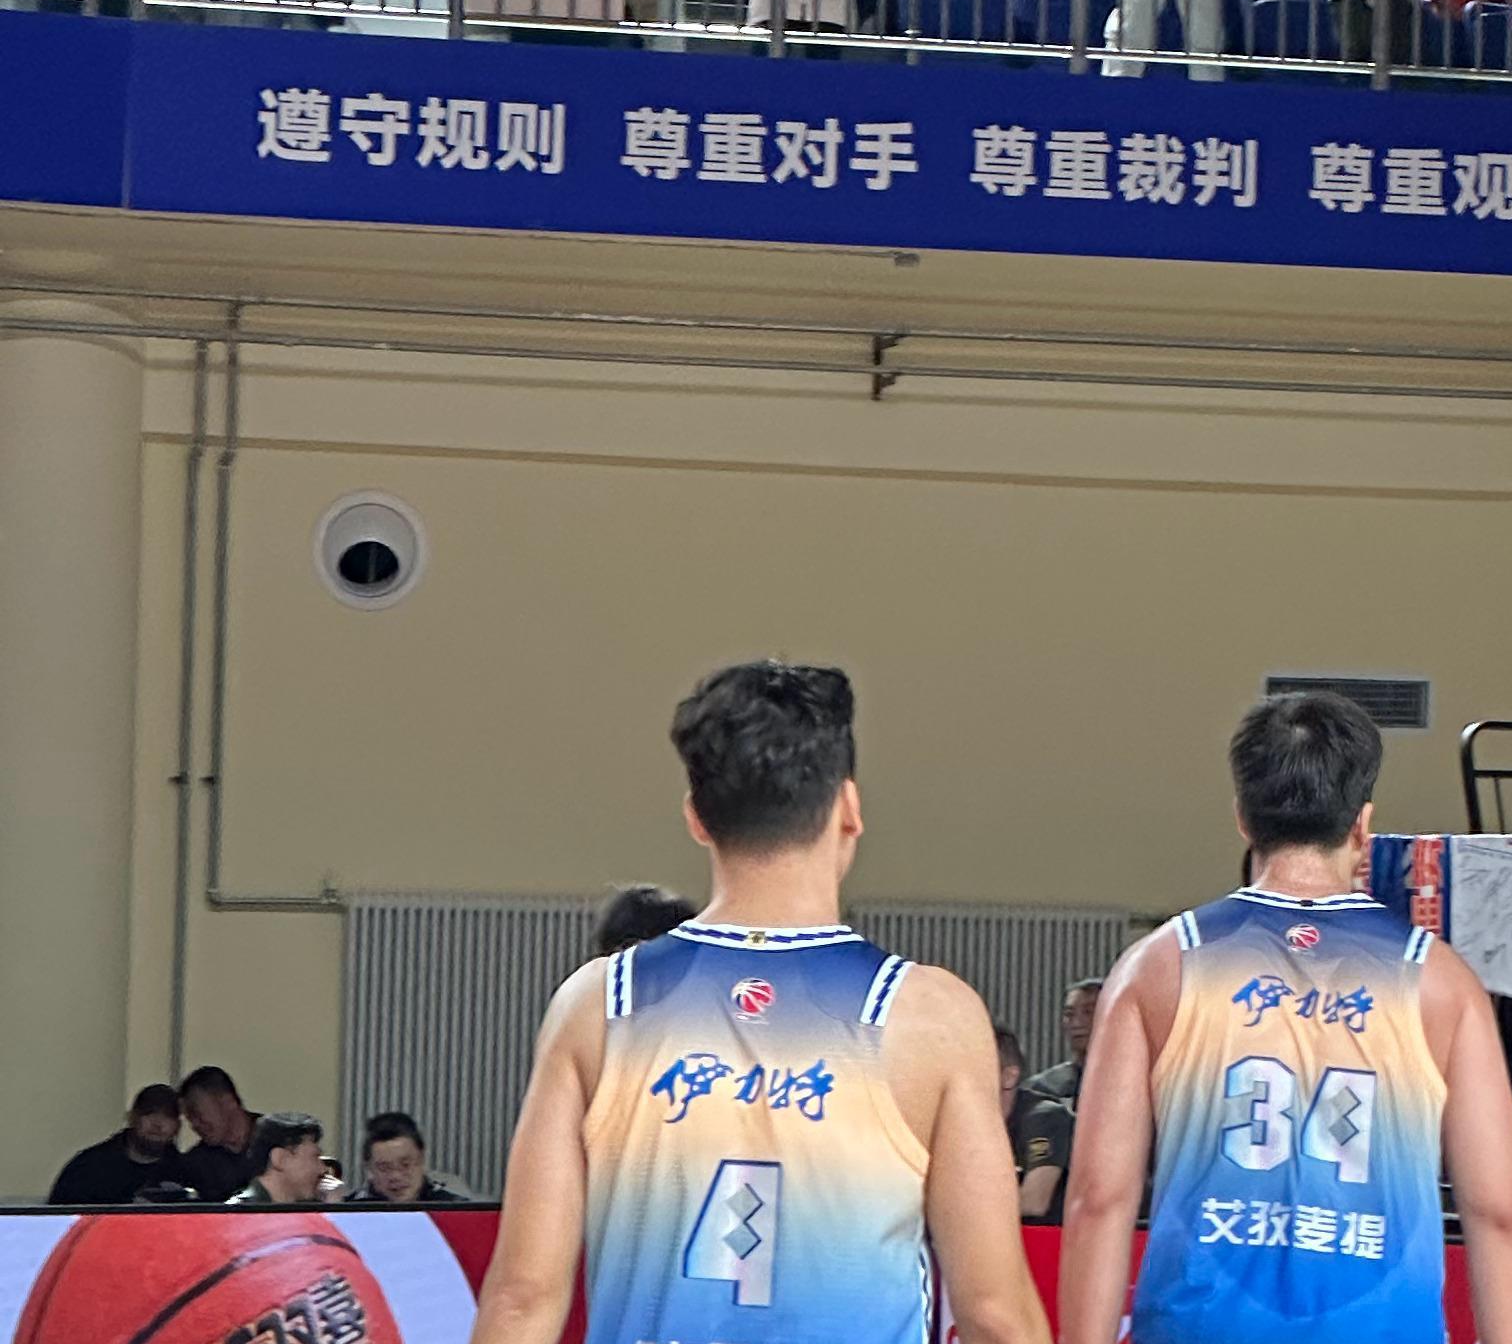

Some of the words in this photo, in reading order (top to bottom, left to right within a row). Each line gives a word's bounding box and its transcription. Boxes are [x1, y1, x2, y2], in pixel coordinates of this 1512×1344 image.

[257, 88, 567, 175] 遵守规则
[620, 107, 919, 191] 尊重对手
[970, 124, 1259, 208] 尊重裁判
[1232, 974, 1374, 1034] 伊力特
[650, 1052, 834, 1124] 伊力特
[1221, 1055, 1377, 1185] 34
[683, 1159, 783, 1309] 4
[1199, 1198, 1384, 1260] 艾孜麦提
